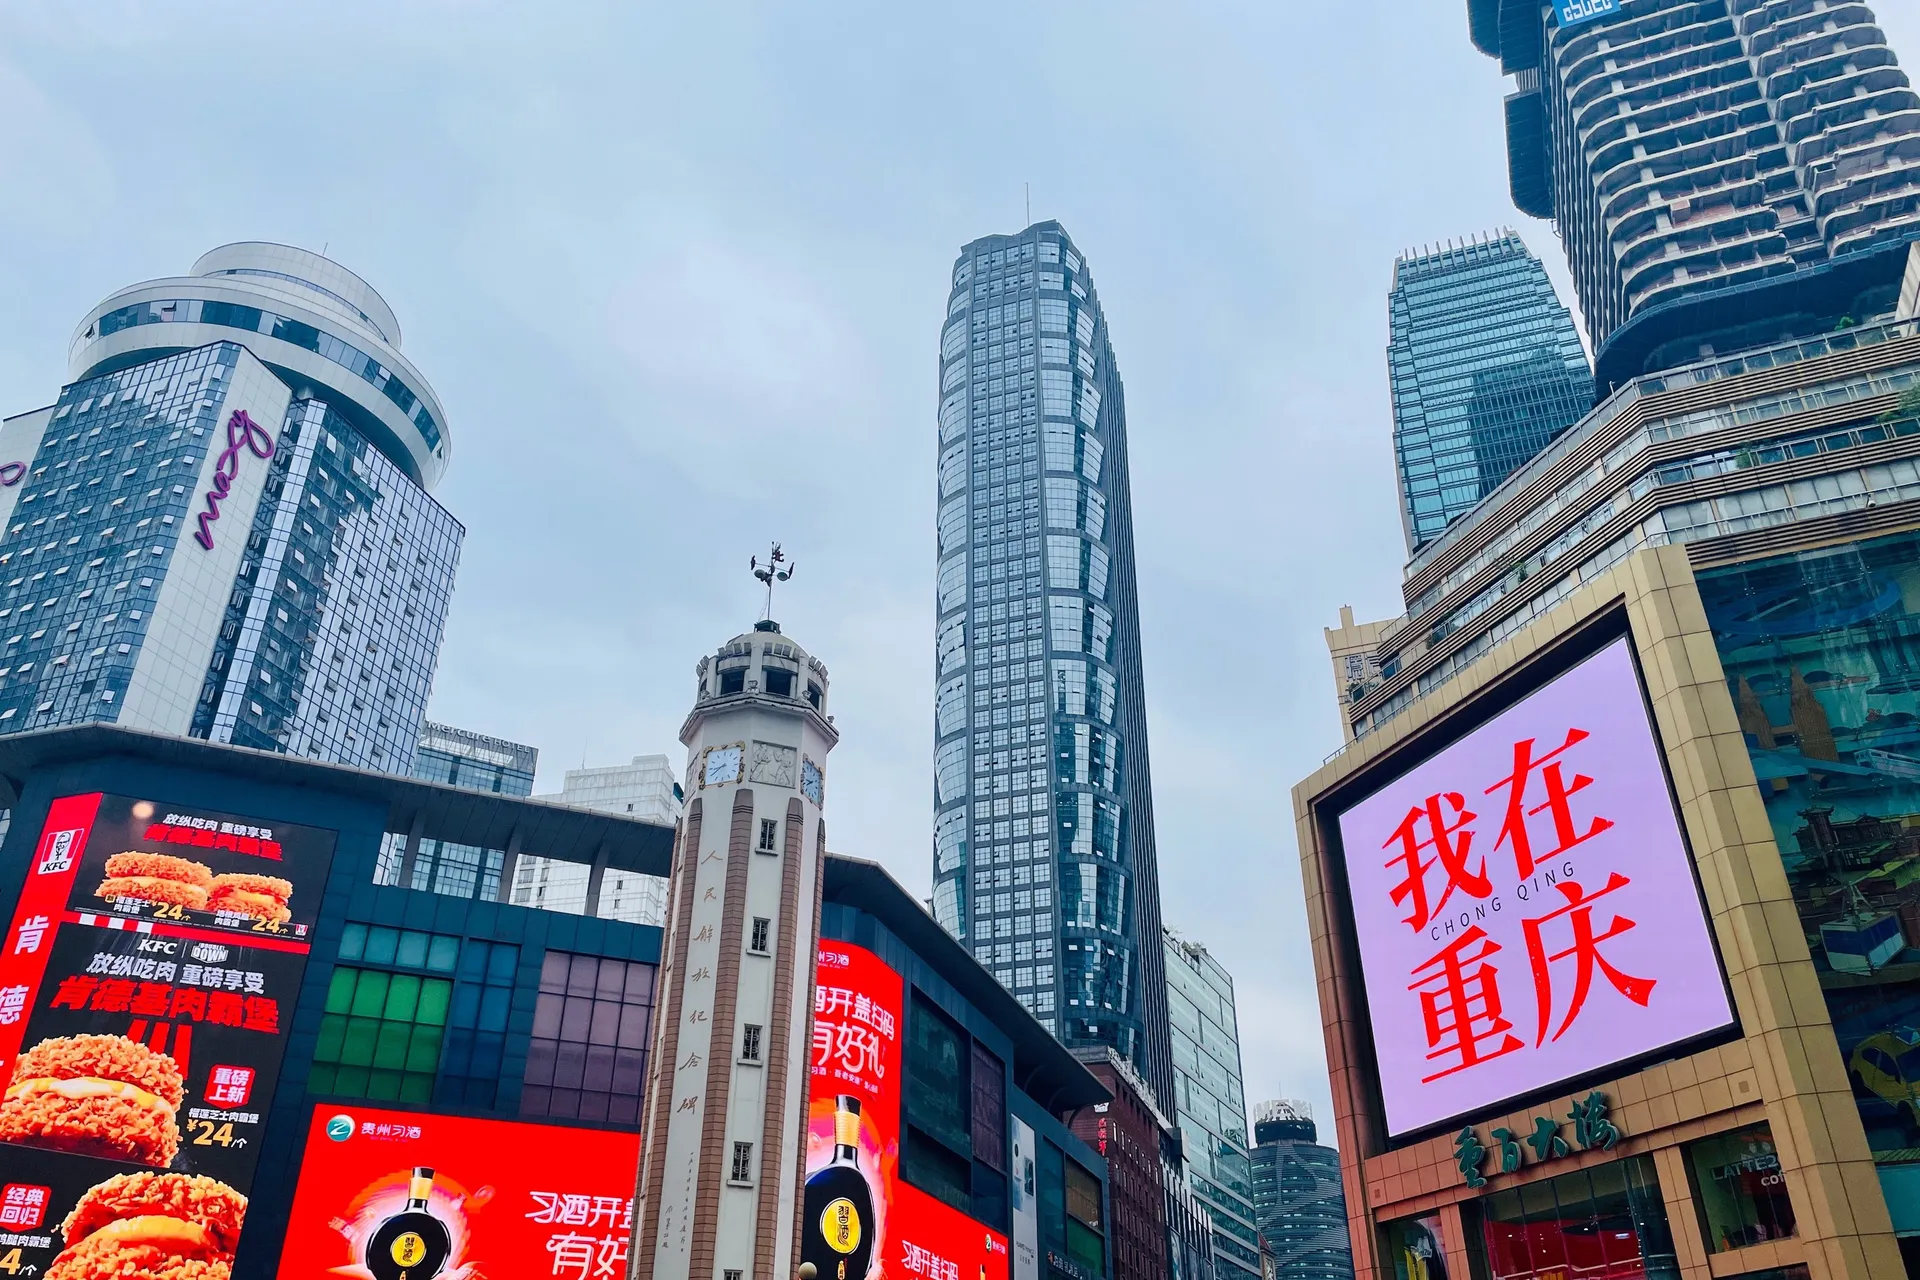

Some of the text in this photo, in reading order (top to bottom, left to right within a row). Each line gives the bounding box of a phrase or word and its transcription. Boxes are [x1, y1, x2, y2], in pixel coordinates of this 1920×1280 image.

[163, 813, 273, 840] 放纵吃肉 重磅享受
[1382, 728, 1614, 934] 我在
[43, 861, 67, 872] KFC
[1431, 861, 1575, 941] CHONG QING
[137, 939, 178, 954] KFC
[193, 947, 227, 961] DOWN
[86, 952, 264, 994] 放纵吃肉 重磅享受
[1407, 872, 1657, 1084] 重庆
[50, 975, 280, 1034] 肯德基肉霸堡
[213, 1068, 251, 1086] 重磅
[209, 1085, 246, 1103] 上新
[361, 1122, 421, 1139] 贵州习酒
[4, 1187, 45, 1206] 经典
[0, 1206, 40, 1225] 回归
[0, 1248, 37, 1276] 4/个
